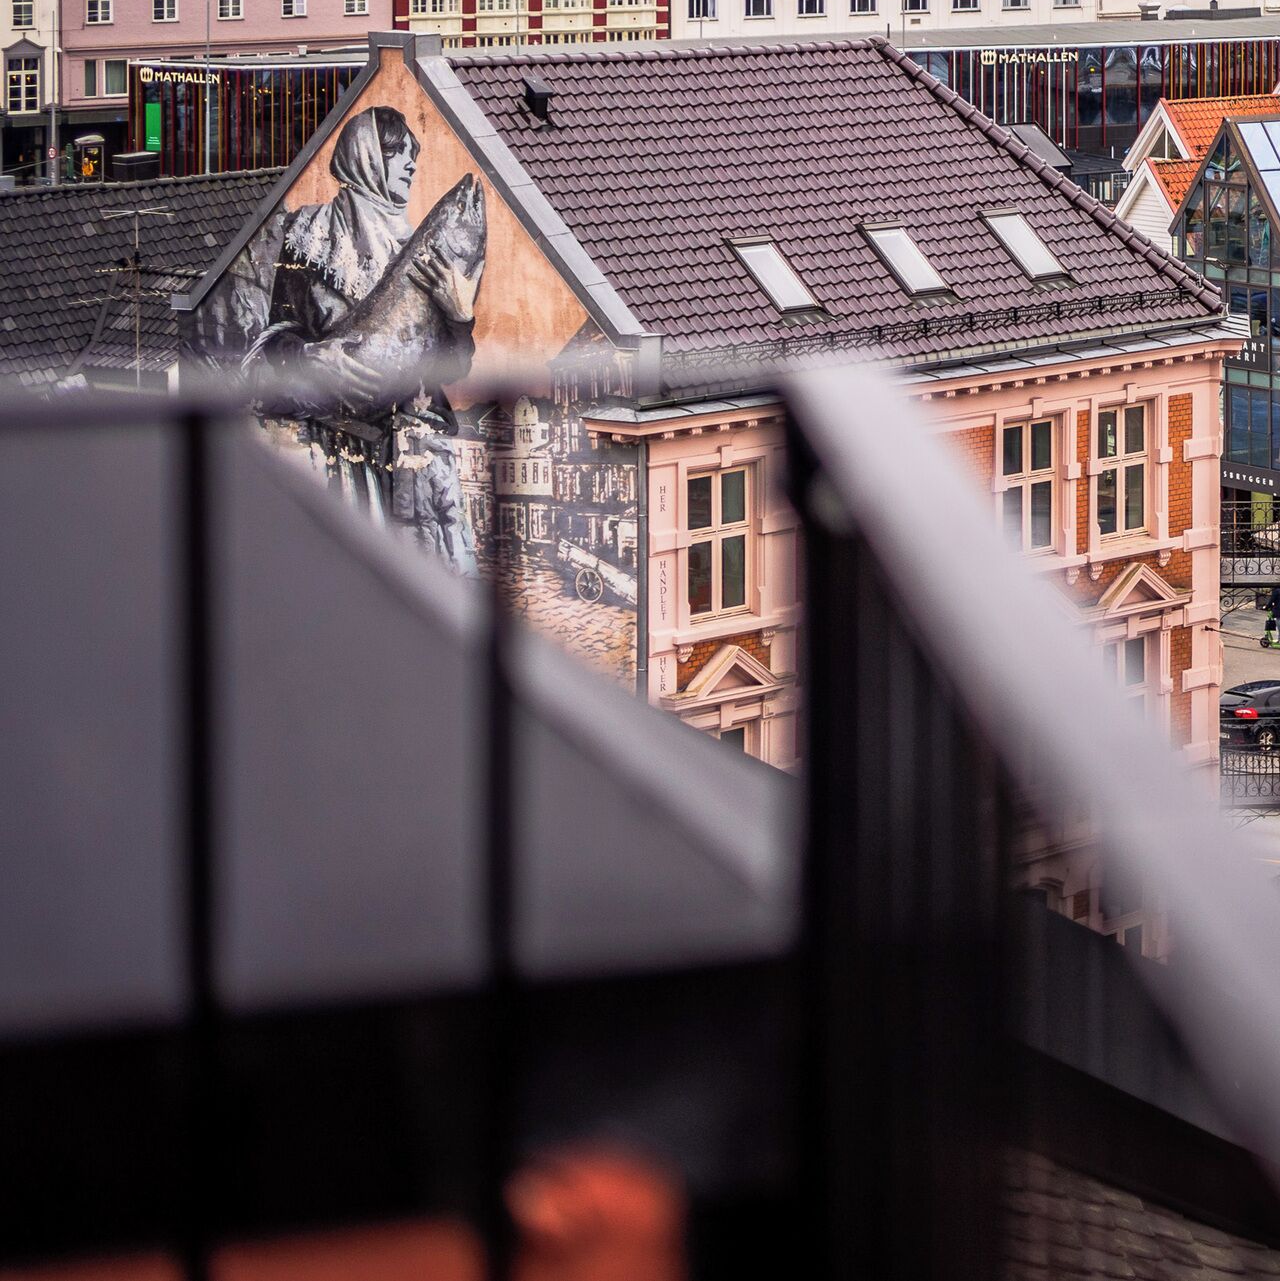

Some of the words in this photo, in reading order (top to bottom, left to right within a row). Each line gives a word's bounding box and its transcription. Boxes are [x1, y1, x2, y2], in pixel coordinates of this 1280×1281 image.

[999, 52, 1079, 64] MATHALLEN
[154, 71, 220, 84] MATHALLEN
[659, 485, 667, 512] HER
